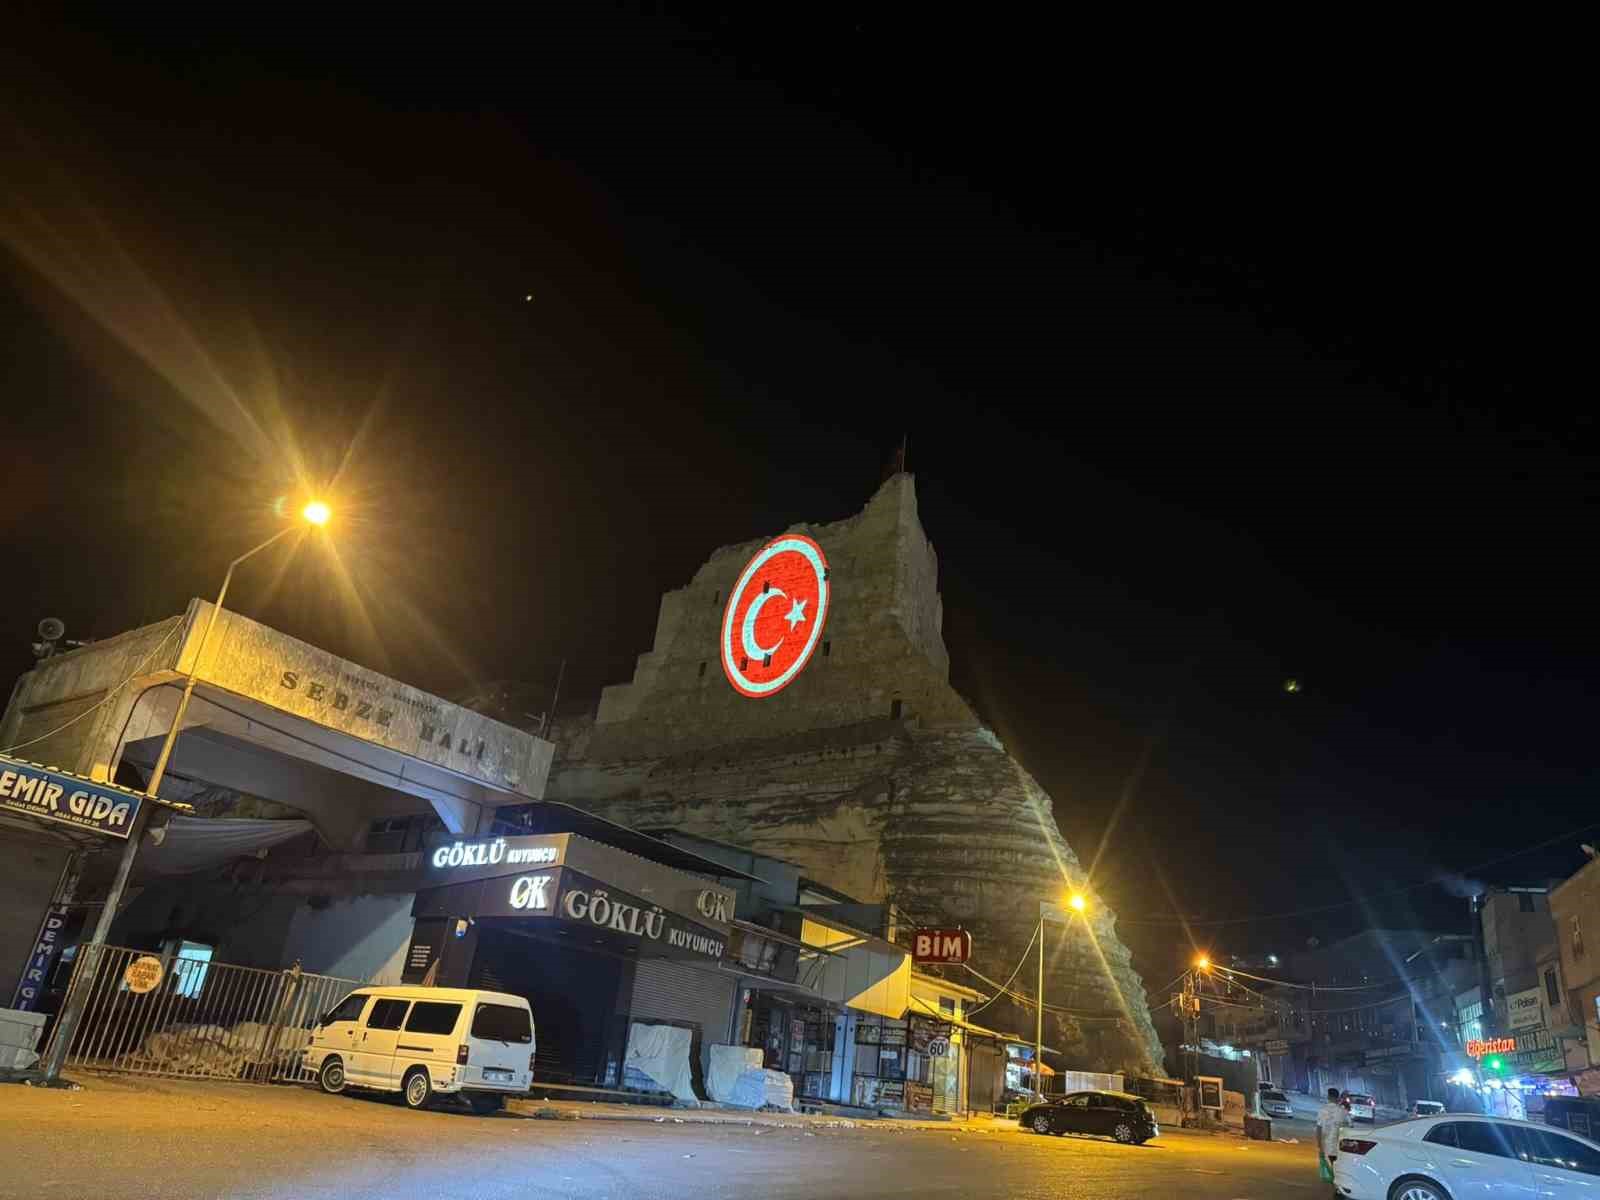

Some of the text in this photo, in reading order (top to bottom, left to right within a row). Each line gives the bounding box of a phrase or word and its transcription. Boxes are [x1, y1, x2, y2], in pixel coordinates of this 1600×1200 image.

[280, 671, 394, 727] SEBZE
[0, 770, 131, 826] EMİR GIDA
[432, 838, 506, 868] GÖKLÜ
[565, 888, 725, 958] GÖKLÜ KUYUMCU
[916, 930, 962, 958] BİM
[929, 1041, 945, 1056] 60
